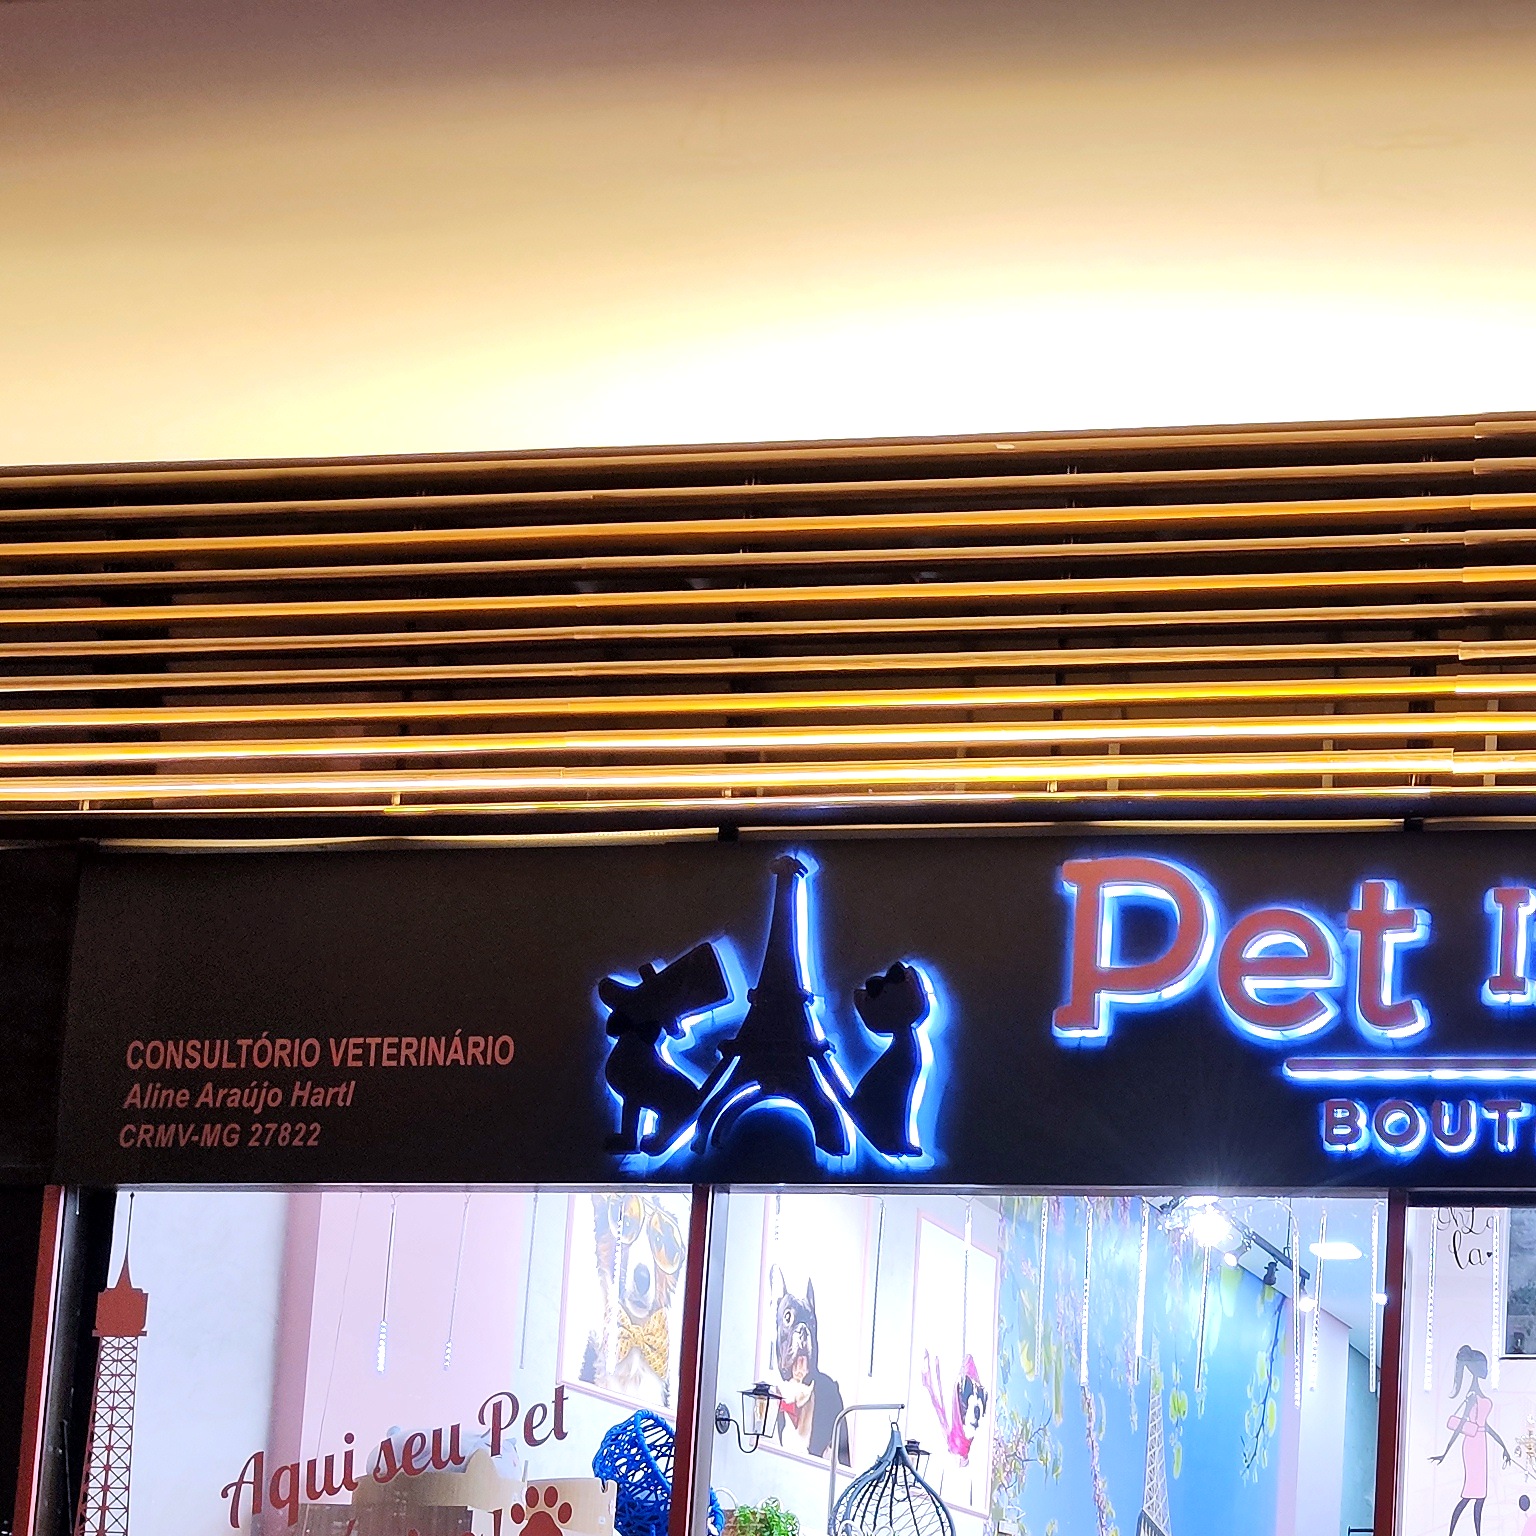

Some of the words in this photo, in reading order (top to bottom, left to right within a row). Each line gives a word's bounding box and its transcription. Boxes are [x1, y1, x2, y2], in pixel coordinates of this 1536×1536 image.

[1052, 855, 1428, 1038] Pet
[126, 1031, 321, 1070] CONSULTÓRIO
[329, 1028, 515, 1067] VETERINÁRIO
[123, 1082, 190, 1109] Aline
[195, 1080, 283, 1114] Araújo
[118, 1123, 241, 1148] CRMV-MG
[248, 1122, 321, 1147] 27822
[220, 1432, 359, 1529] Aqui
[372, 1422, 466, 1484] seu
[477, 1384, 570, 1457] Pet
